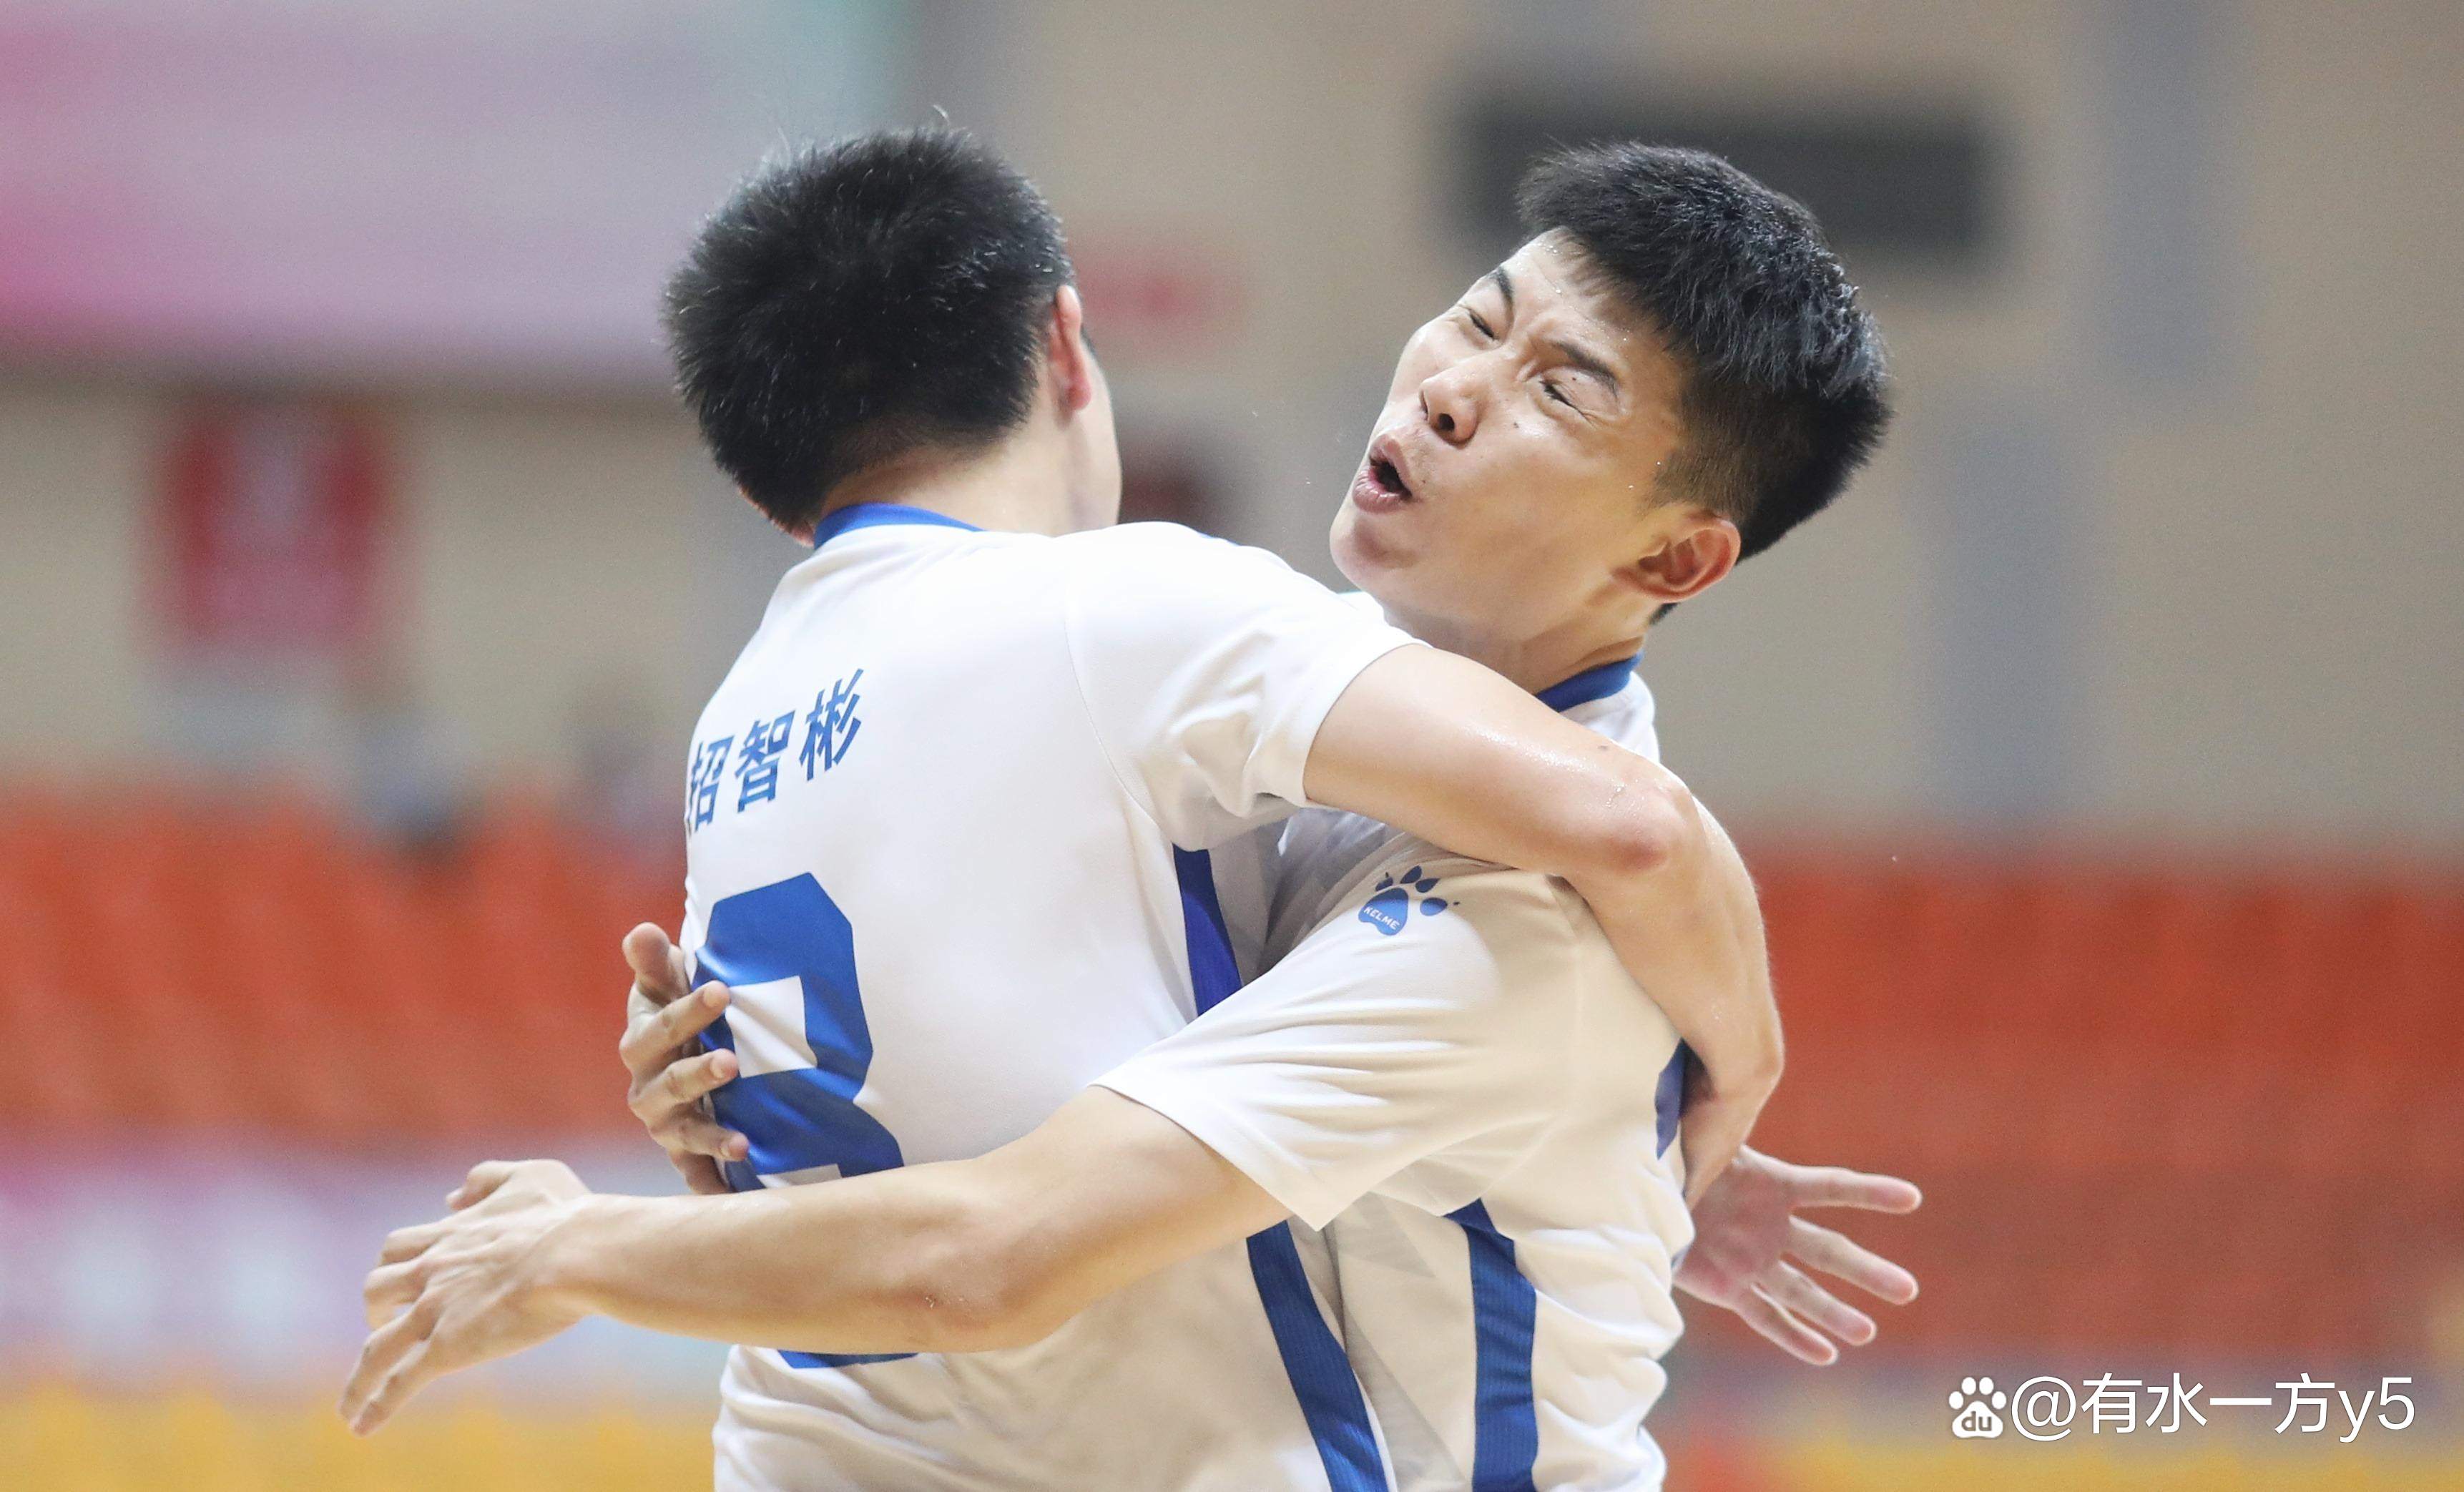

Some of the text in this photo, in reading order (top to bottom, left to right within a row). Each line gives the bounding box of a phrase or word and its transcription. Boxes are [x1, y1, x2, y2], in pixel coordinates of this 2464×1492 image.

[687, 668, 864, 835] 招智彬
[1363, 905, 1400, 931] KELME
[692, 872, 918, 1368] 8
